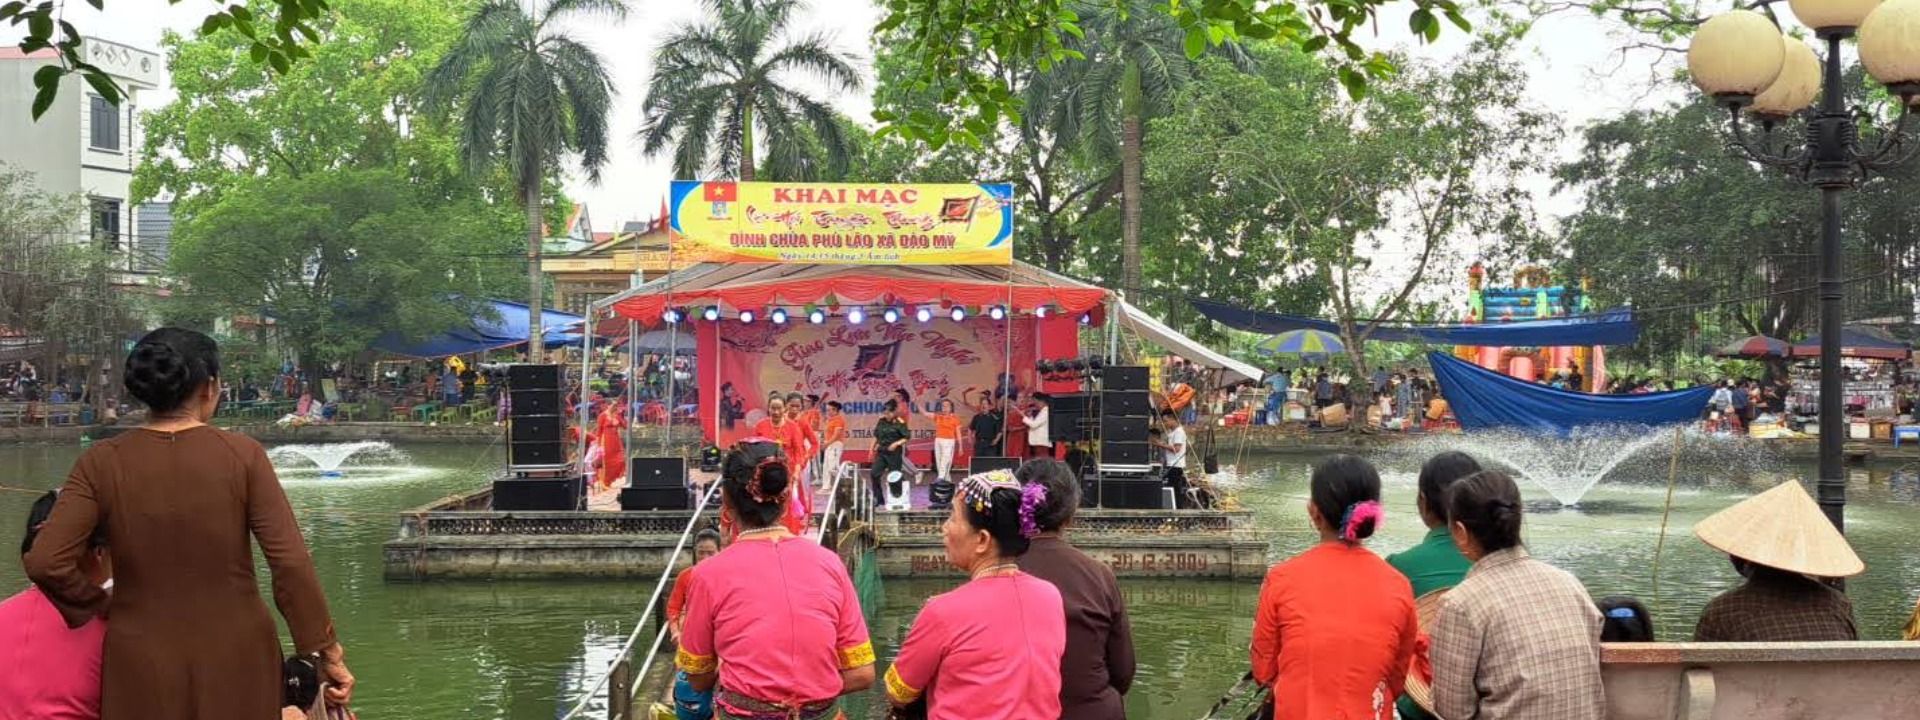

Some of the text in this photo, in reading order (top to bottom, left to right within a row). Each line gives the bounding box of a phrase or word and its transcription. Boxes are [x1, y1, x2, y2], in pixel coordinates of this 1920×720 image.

[774, 187, 918, 208] KHAI MẠC
[769, 230, 809, 248] CHÙA
[845, 231, 874, 249] LÃO
[877, 231, 897, 249] XÃ
[933, 232, 956, 249] MỸ
[780, 340, 824, 371] Giao
